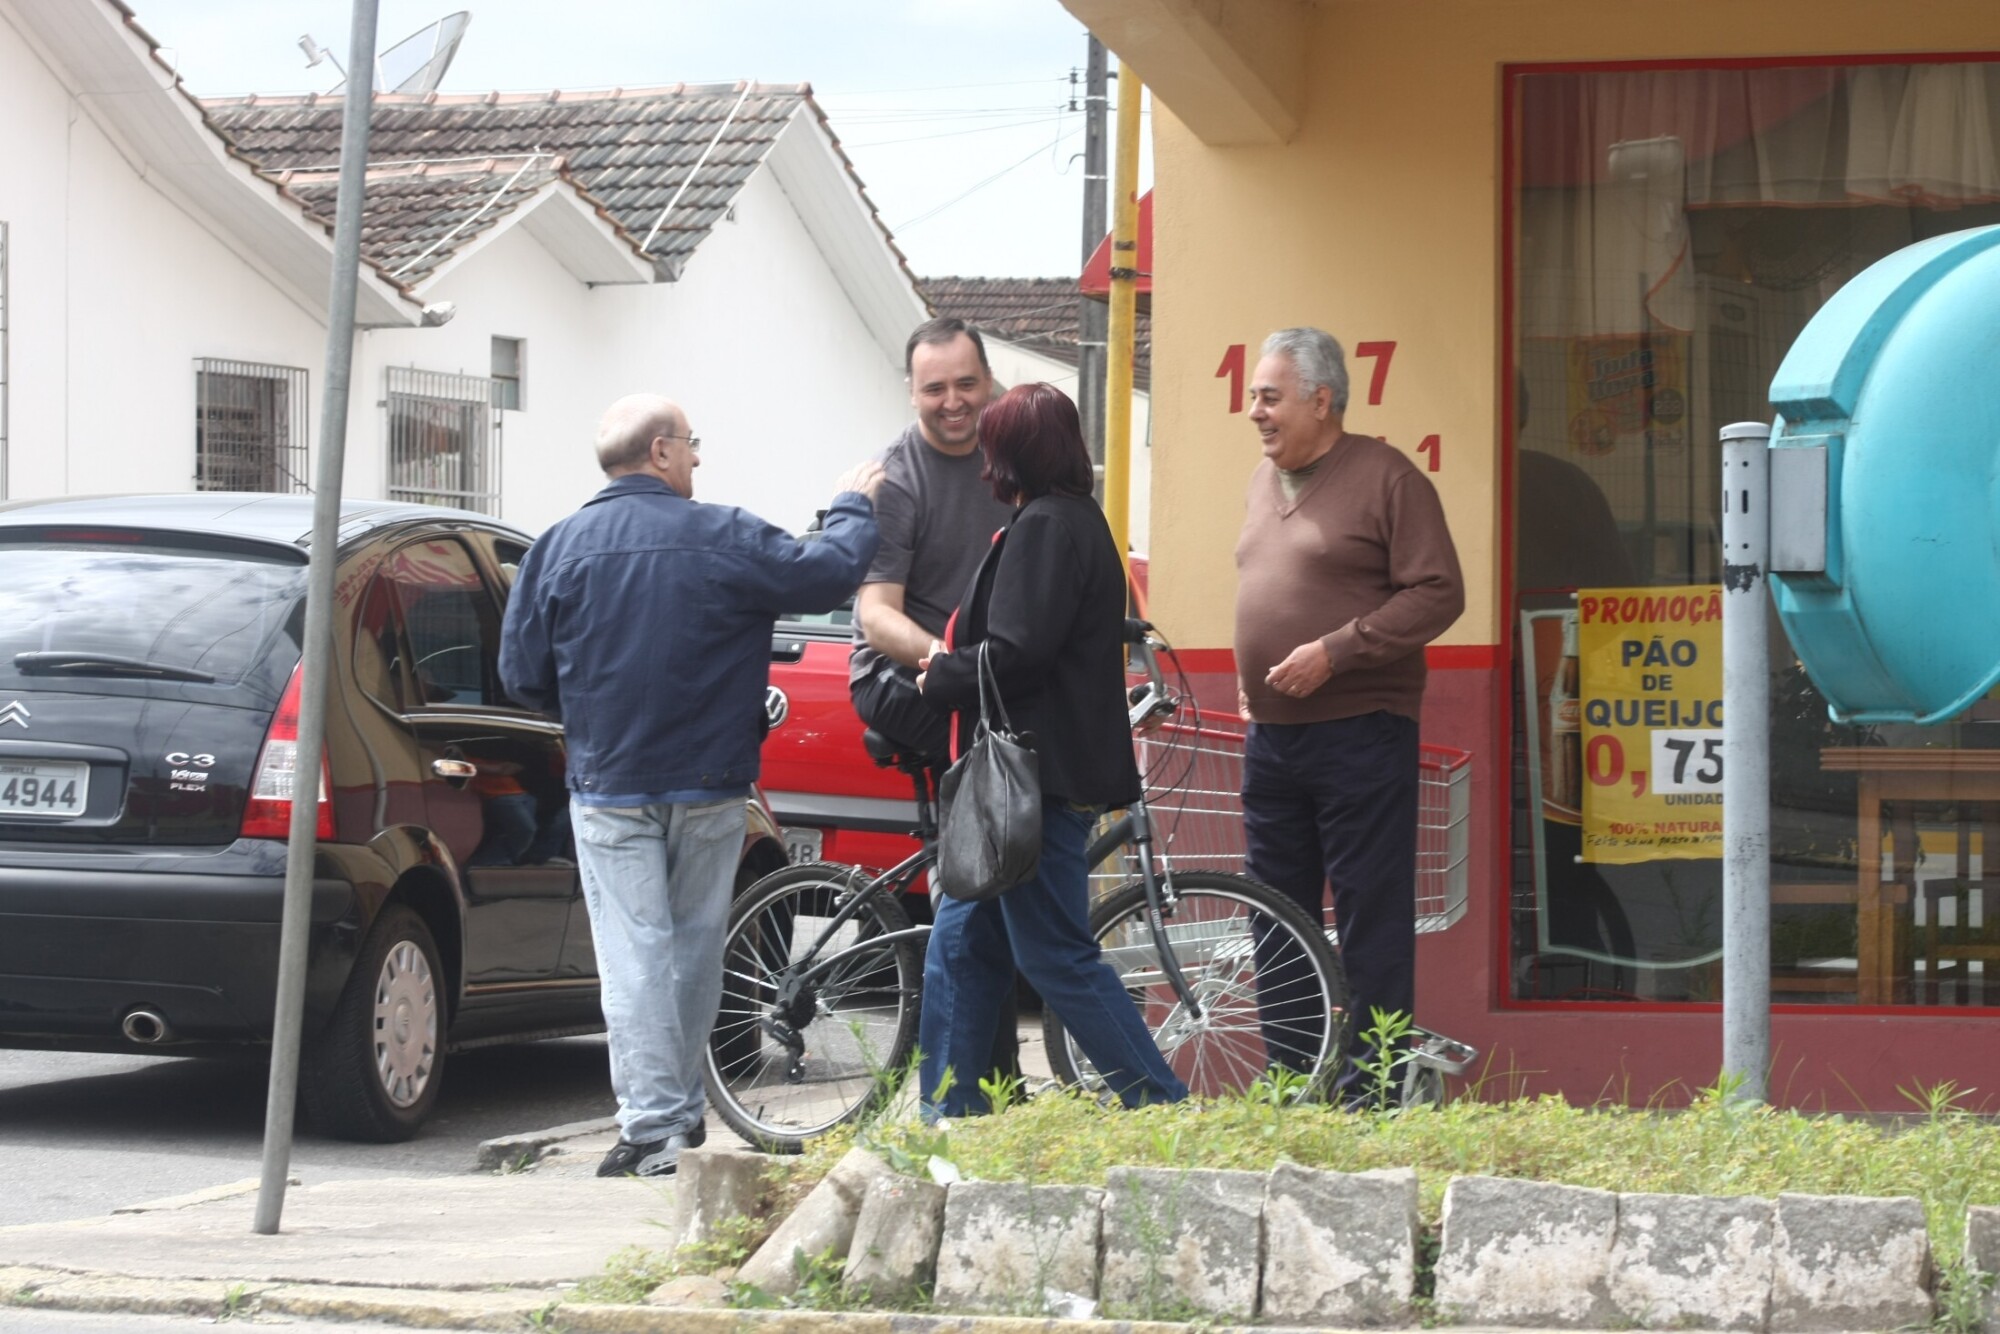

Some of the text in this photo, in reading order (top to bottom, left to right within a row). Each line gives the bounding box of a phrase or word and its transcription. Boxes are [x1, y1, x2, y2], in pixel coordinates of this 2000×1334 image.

[1580, 589, 1723, 625] PROMOÇÃ
[1621, 635, 1697, 667] PÃO
[1642, 674, 1673, 691] DE
[164, 752, 216, 768] C3
[2, 777, 77, 808] 4944
[1664, 794, 1723, 806] UNIDAD
[1609, 820, 1723, 835] 100% NATURA
[786, 842, 814, 863] 48
